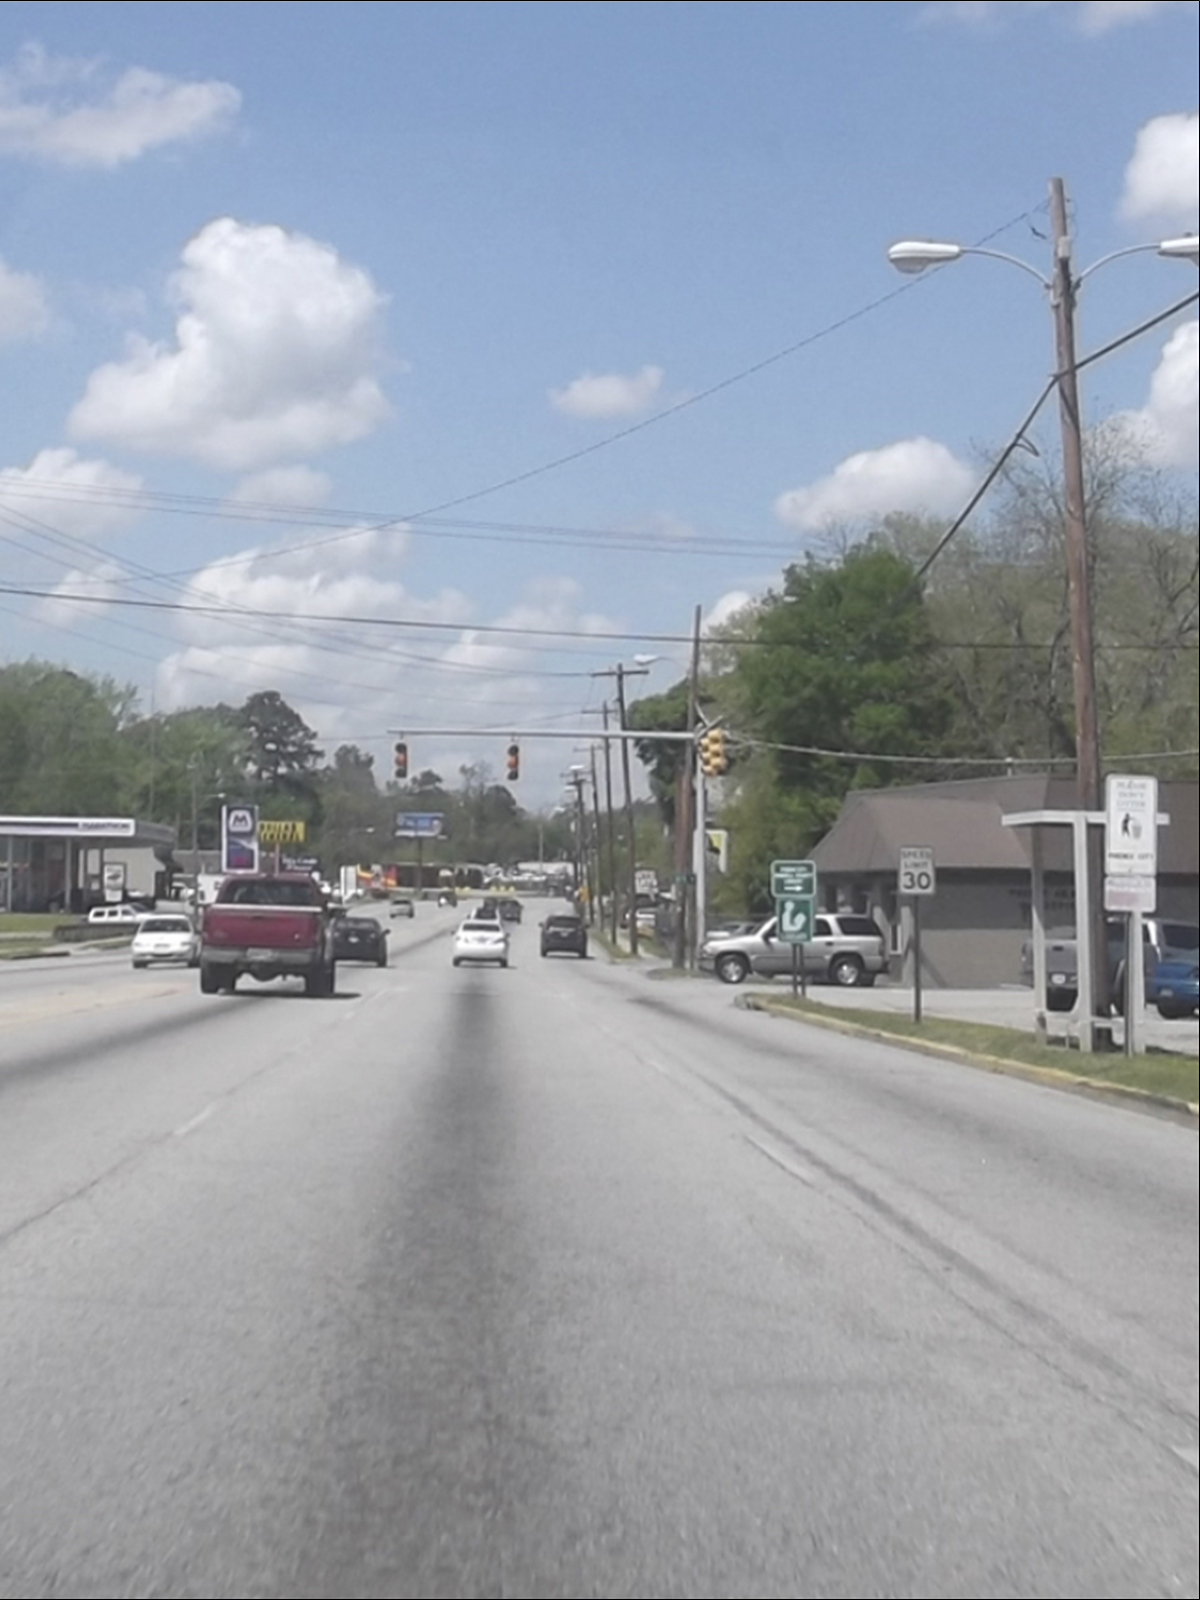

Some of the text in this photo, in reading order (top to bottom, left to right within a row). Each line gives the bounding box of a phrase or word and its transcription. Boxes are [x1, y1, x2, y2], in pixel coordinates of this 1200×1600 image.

[901, 850, 931, 859] SPEED
[904, 861, 928, 869] LIMIT
[903, 871, 931, 890] 30
